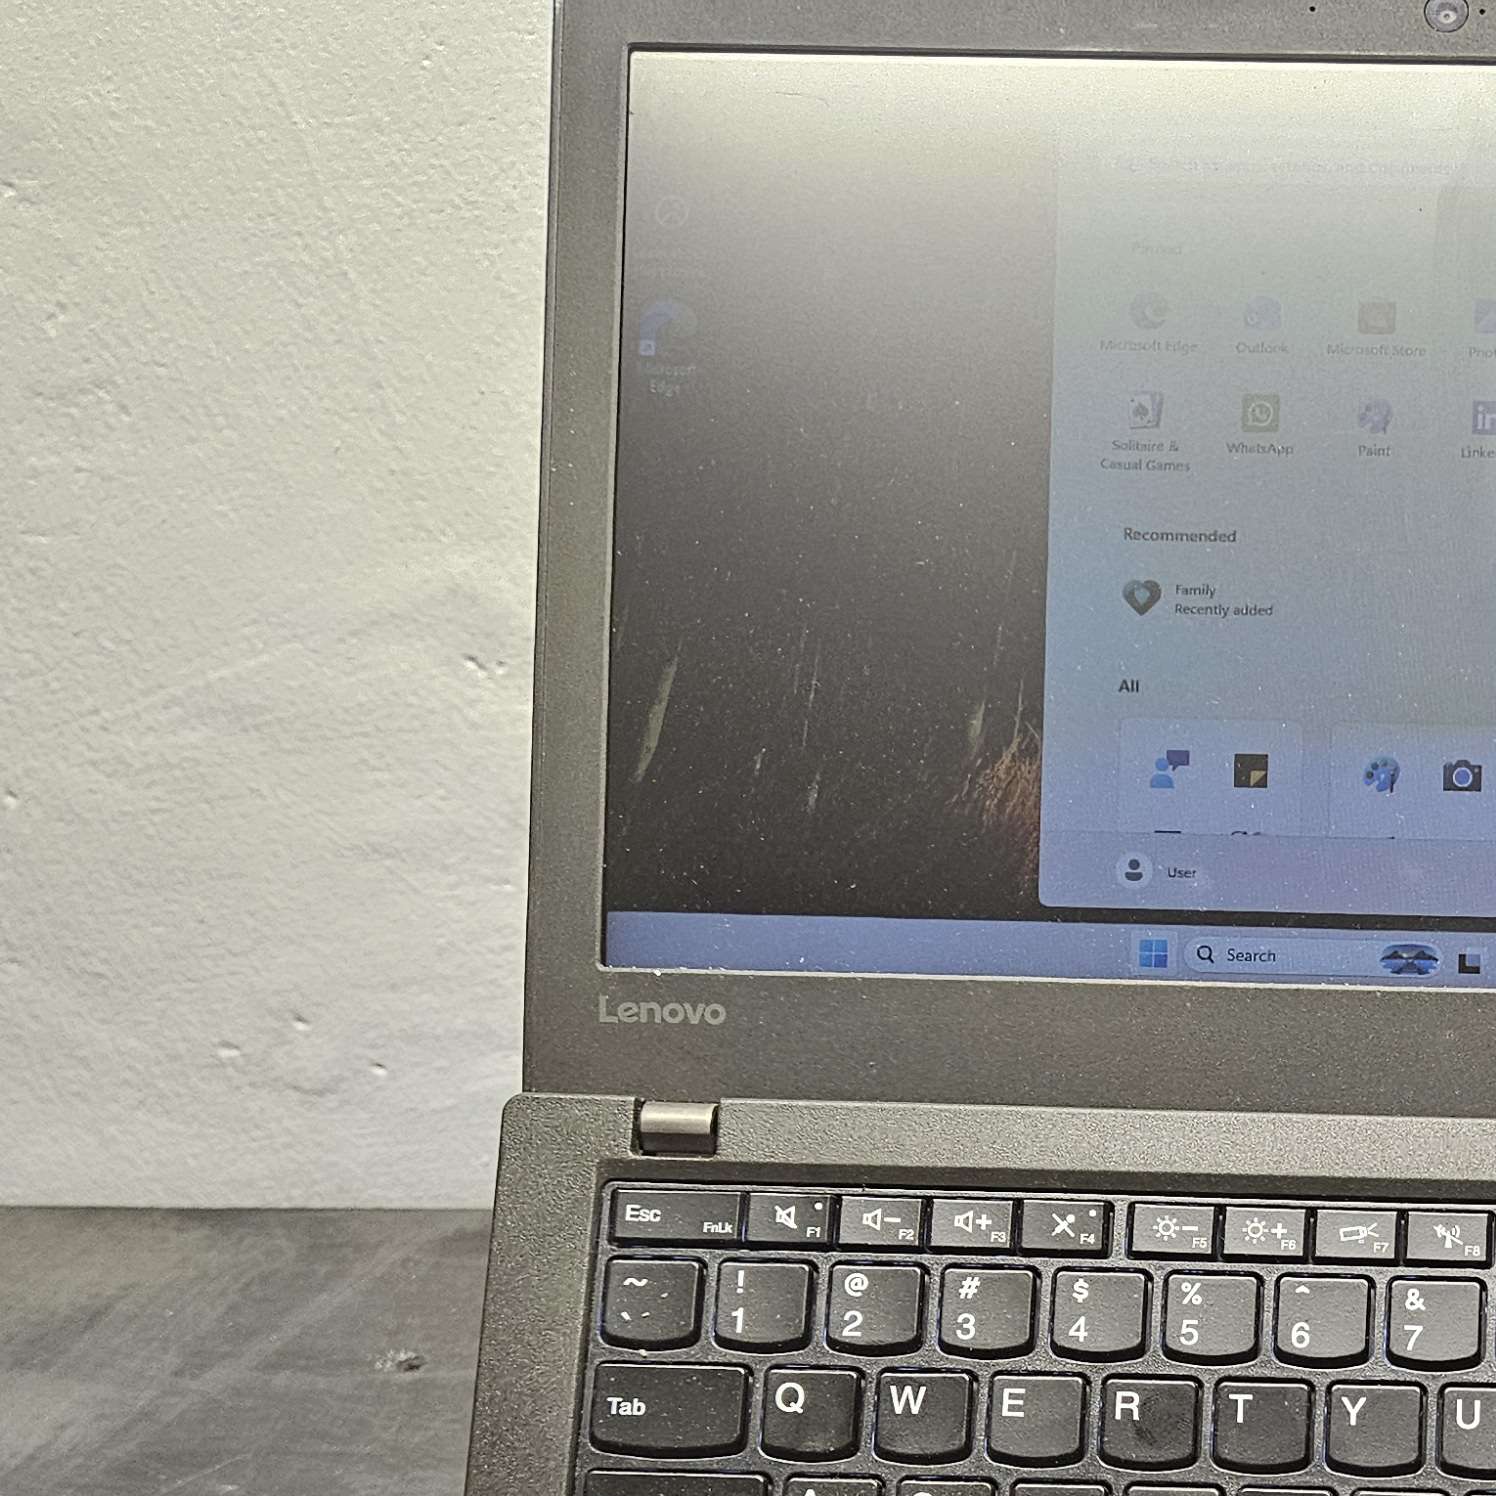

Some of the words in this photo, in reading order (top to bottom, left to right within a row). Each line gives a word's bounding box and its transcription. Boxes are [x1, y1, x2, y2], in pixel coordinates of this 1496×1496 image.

[1099, 339, 1161, 352] Microsoft
[1164, 339, 1199, 356] Edge
[1235, 341, 1289, 355] Outlook
[1326, 343, 1388, 357] Microsoft
[1392, 344, 1427, 358] Store
[1111, 439, 1164, 453] Solitaire
[1226, 441, 1295, 457] WhatsApp
[1357, 444, 1392, 458] Paint
[1099, 457, 1143, 472] Casual
[1145, 459, 1191, 473] Games
[1123, 527, 1238, 544] Recommended
[1174, 584, 1217, 600] Family
[1174, 603, 1230, 619] Recently
[1232, 604, 1274, 617] added
[1117, 679, 1140, 694] All
[1167, 867, 1198, 879] User
[1226, 948, 1277, 963] Search
[598, 995, 728, 1026] Lenovo
[625, 1204, 662, 1223] Esc
[702, 1221, 733, 1234] FnLk
[806, 1226, 821, 1238] F1
[898, 1228, 915, 1241] F2
[990, 1231, 1007, 1243] F3
[1079, 1233, 1096, 1245] F4
[1191, 1237, 1208, 1249] F5
[1280, 1239, 1297, 1251] F6
[1373, 1241, 1390, 1254] F7
[1464, 1245, 1481, 1257] F8
[731, 1307, 745, 1334] 1
[841, 1310, 864, 1337] 2
[955, 1312, 976, 1341] 3
[1068, 1315, 1089, 1343] 4
[1179, 1319, 1199, 1346] 5
[1291, 1321, 1310, 1349] 6
[1403, 1324, 1424, 1351] 7
[606, 1396, 646, 1416] Tab
[775, 1382, 805, 1414] Q
[889, 1385, 927, 1415] W
[1001, 1387, 1026, 1418] E
[1114, 1390, 1140, 1421] R
[1228, 1393, 1254, 1424] T
[1341, 1396, 1367, 1426] Y
[1455, 1398, 1481, 1430] U
